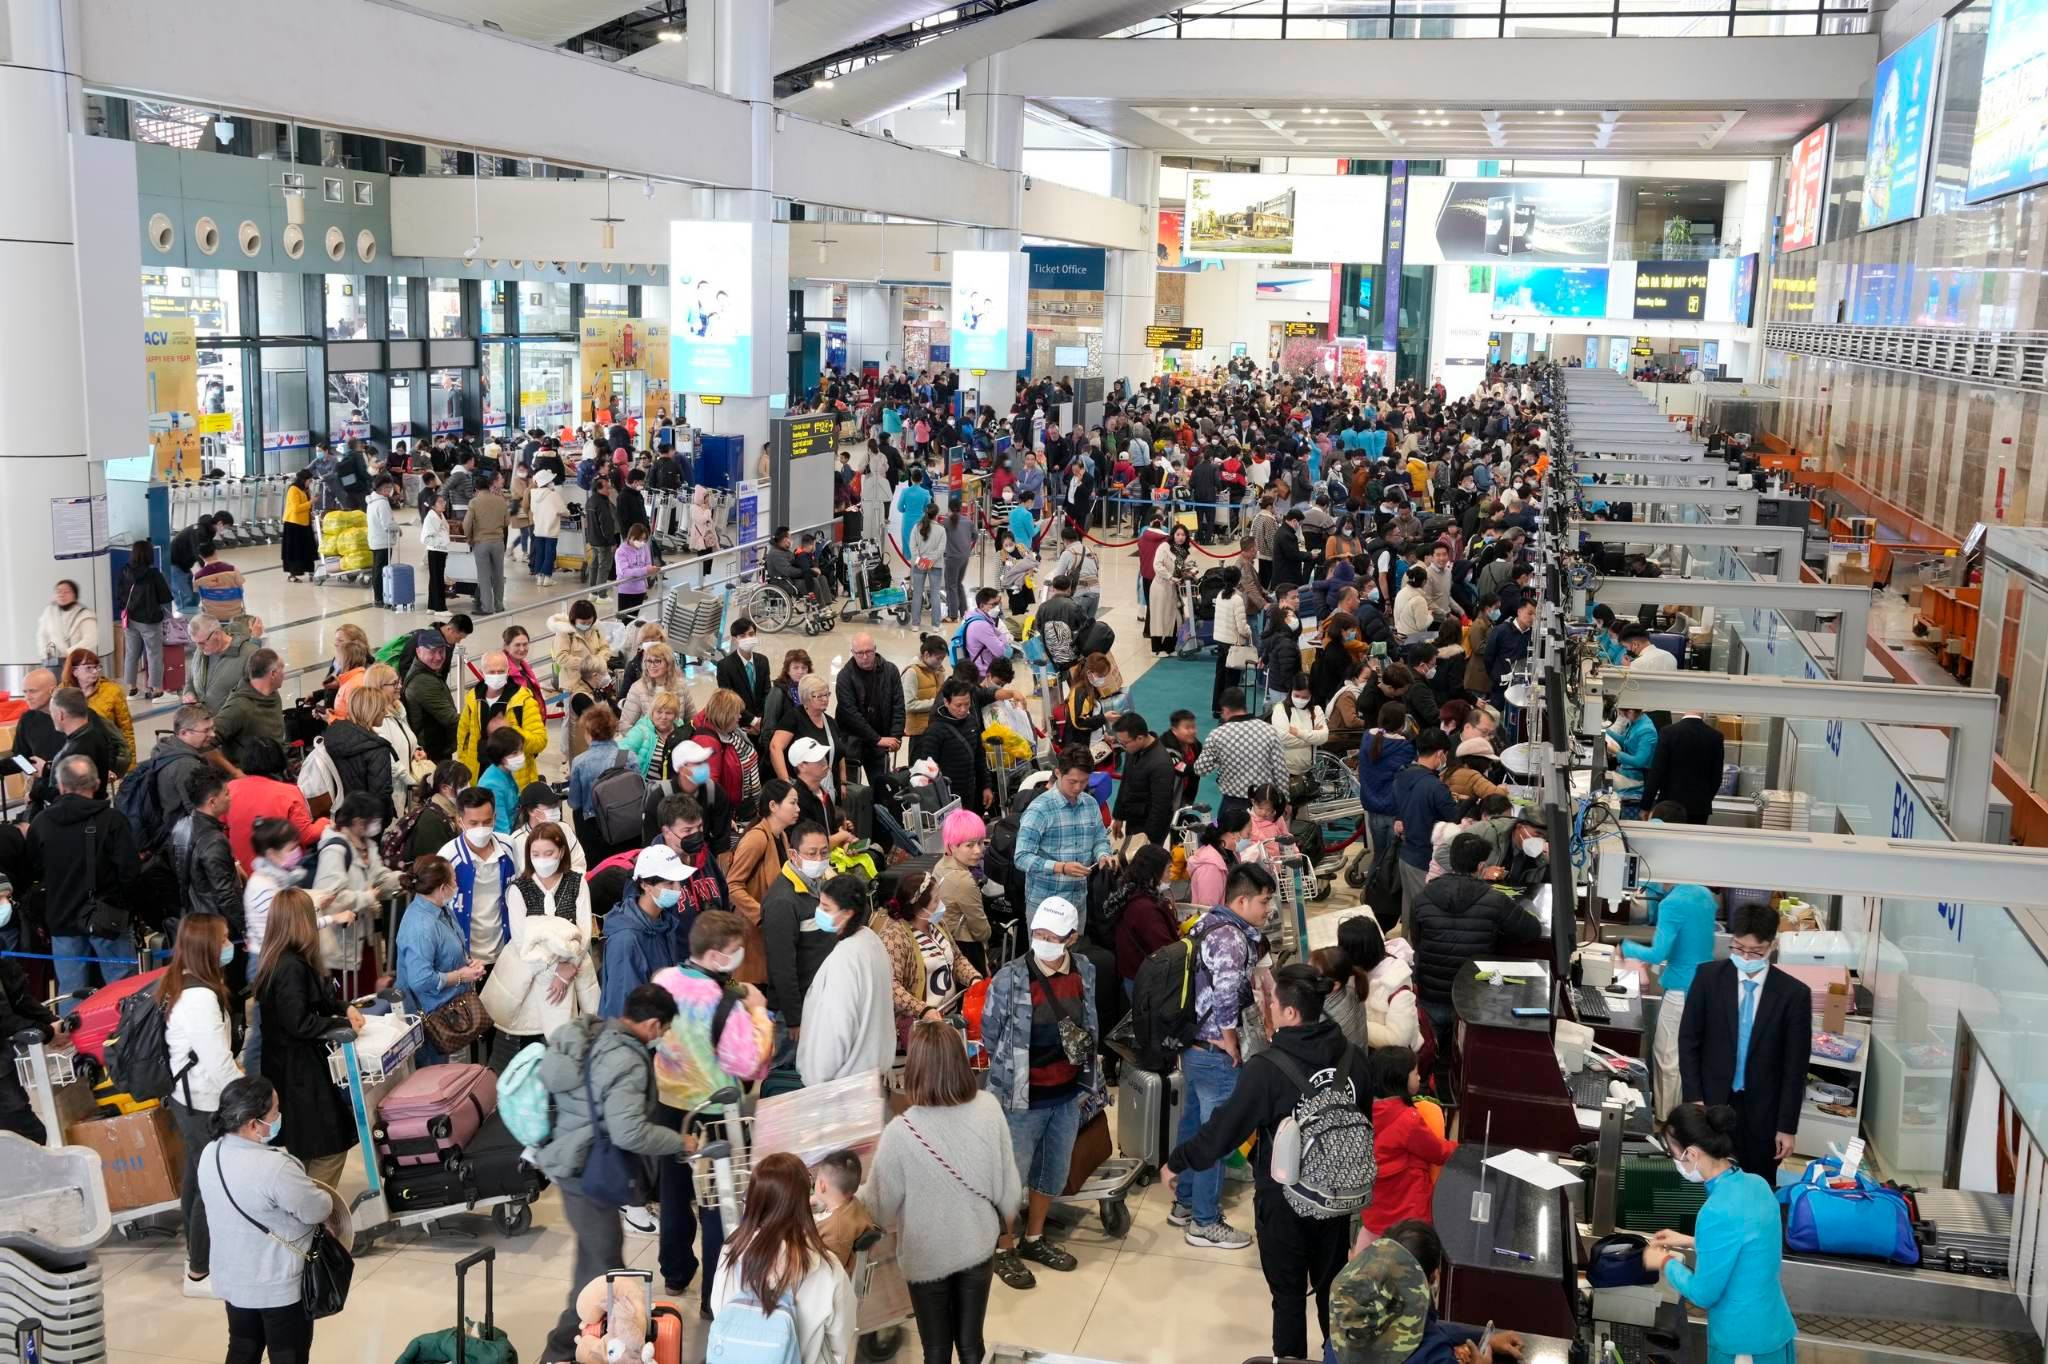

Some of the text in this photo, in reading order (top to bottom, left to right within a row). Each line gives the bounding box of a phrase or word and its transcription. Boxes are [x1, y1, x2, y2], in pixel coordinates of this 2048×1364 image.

[1034, 263, 1088, 274] Ticket Office
[533, 295, 539, 304] 7
[144, 331, 169, 346] ACV
[177, 354, 191, 362] YEAR
